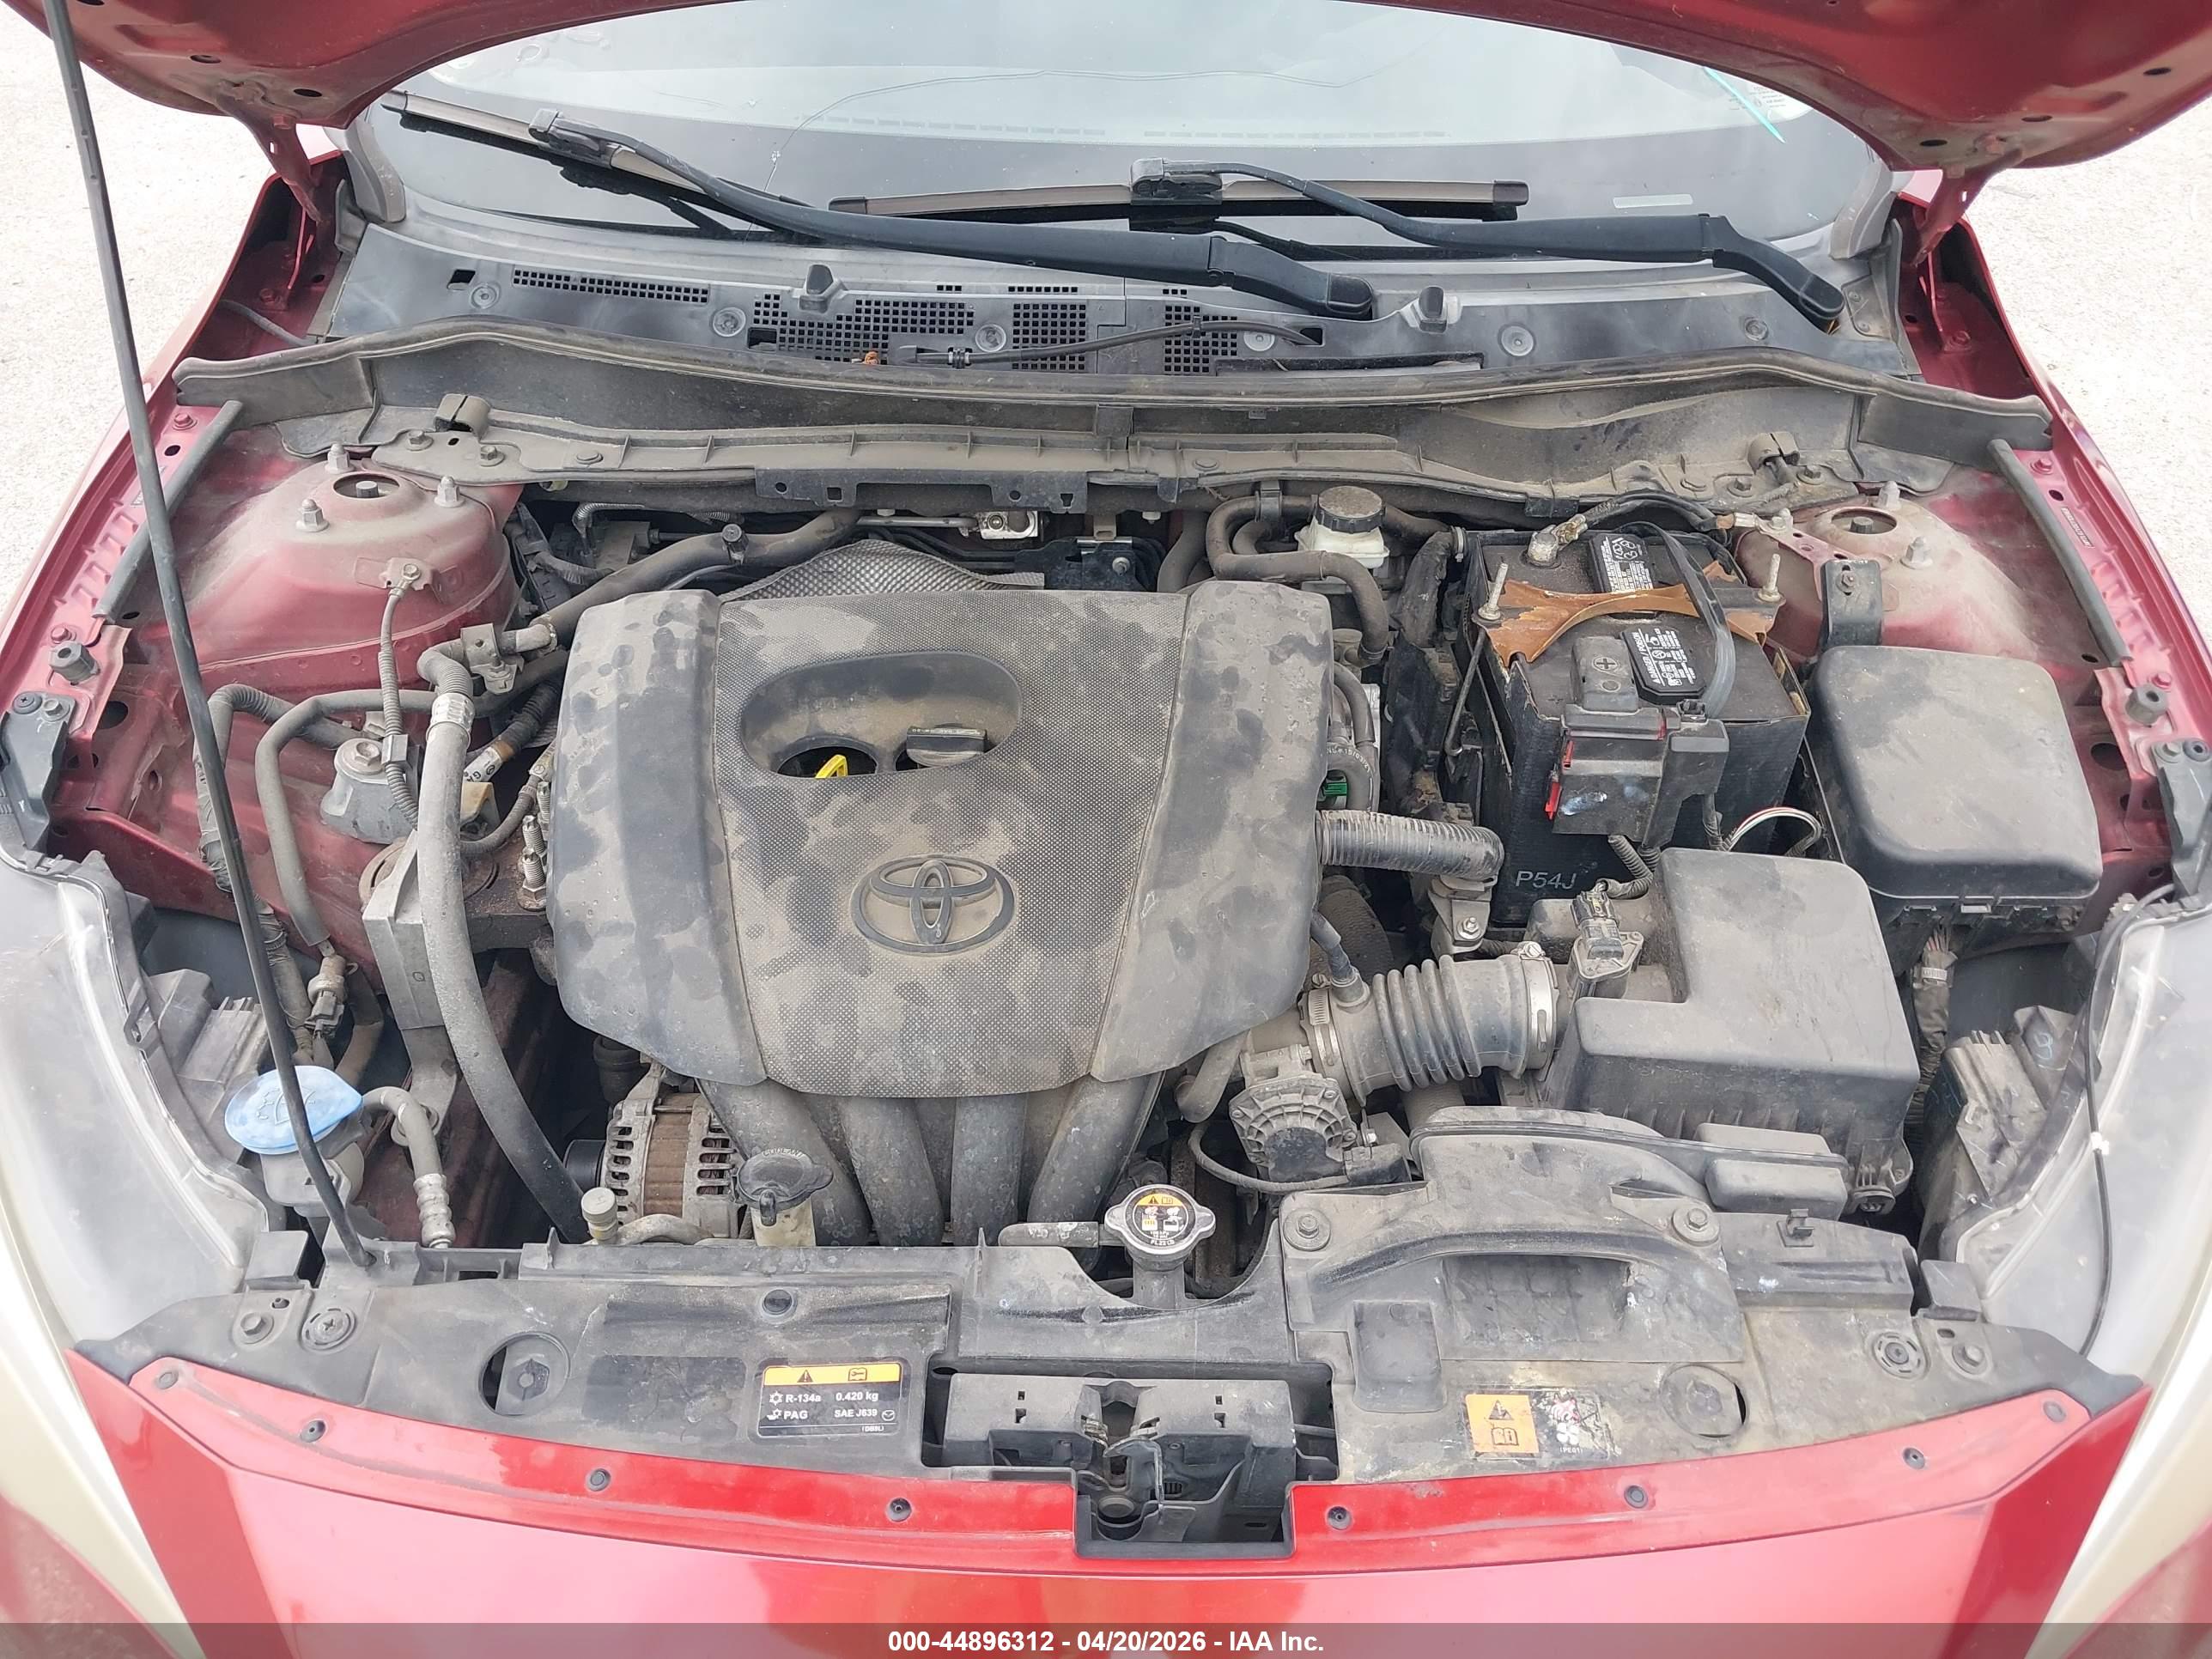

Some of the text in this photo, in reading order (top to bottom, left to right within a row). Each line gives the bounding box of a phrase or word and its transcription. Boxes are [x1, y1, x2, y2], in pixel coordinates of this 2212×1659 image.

[1515, 871, 1577, 890] P54J
[785, 1391, 879, 1403] R-134a 0.420 kg
[783, 1408, 878, 1420] PAG SAE J639
